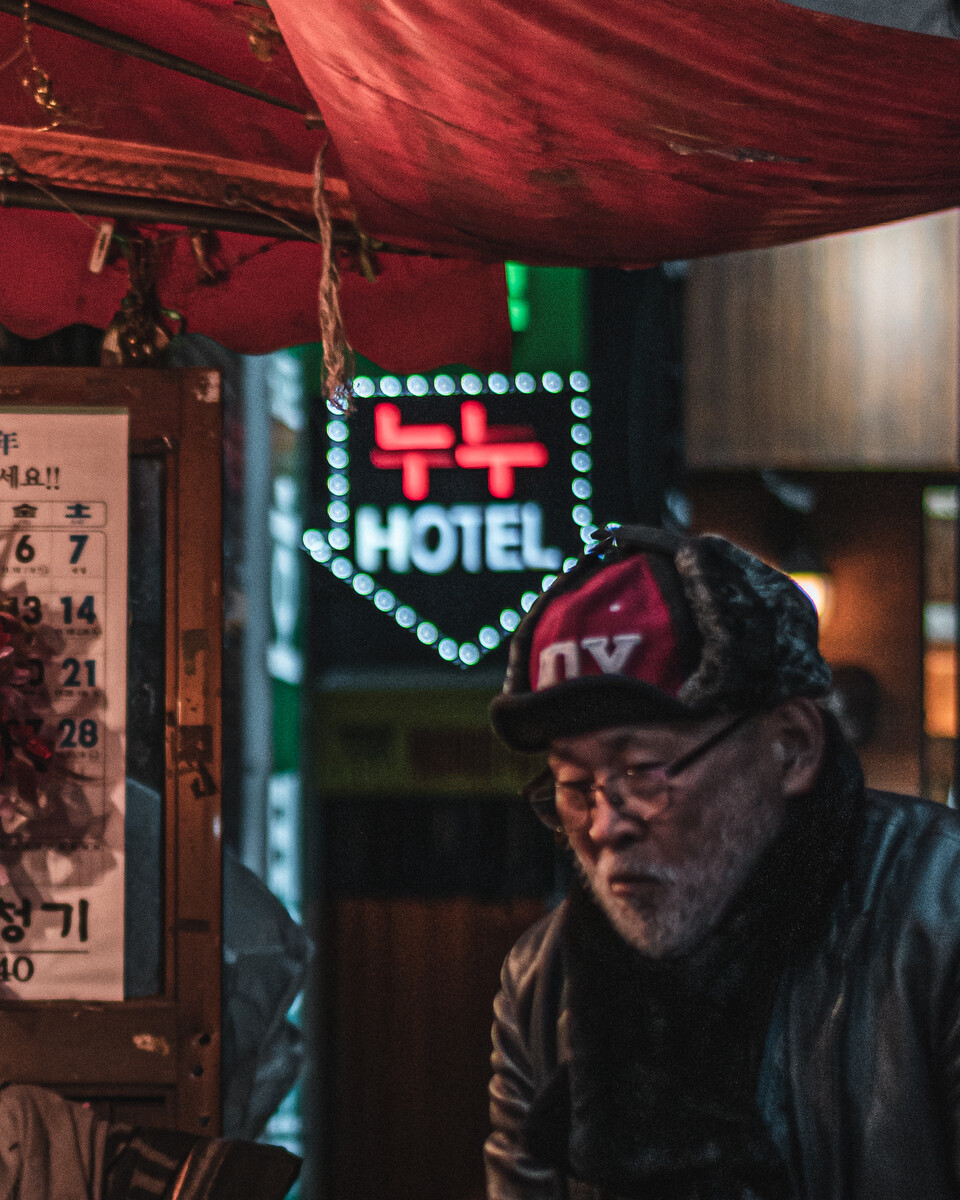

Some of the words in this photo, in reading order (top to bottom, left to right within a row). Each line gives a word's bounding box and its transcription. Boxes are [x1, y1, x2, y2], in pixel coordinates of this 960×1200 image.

[64, 503, 92, 518] 土
[15, 535, 36, 564] 6
[70, 535, 90, 565] 7
[354, 502, 562, 575] HOTEL
[60, 596, 96, 624] 14
[62, 658, 96, 686] 21
[58, 719, 98, 748] 28
